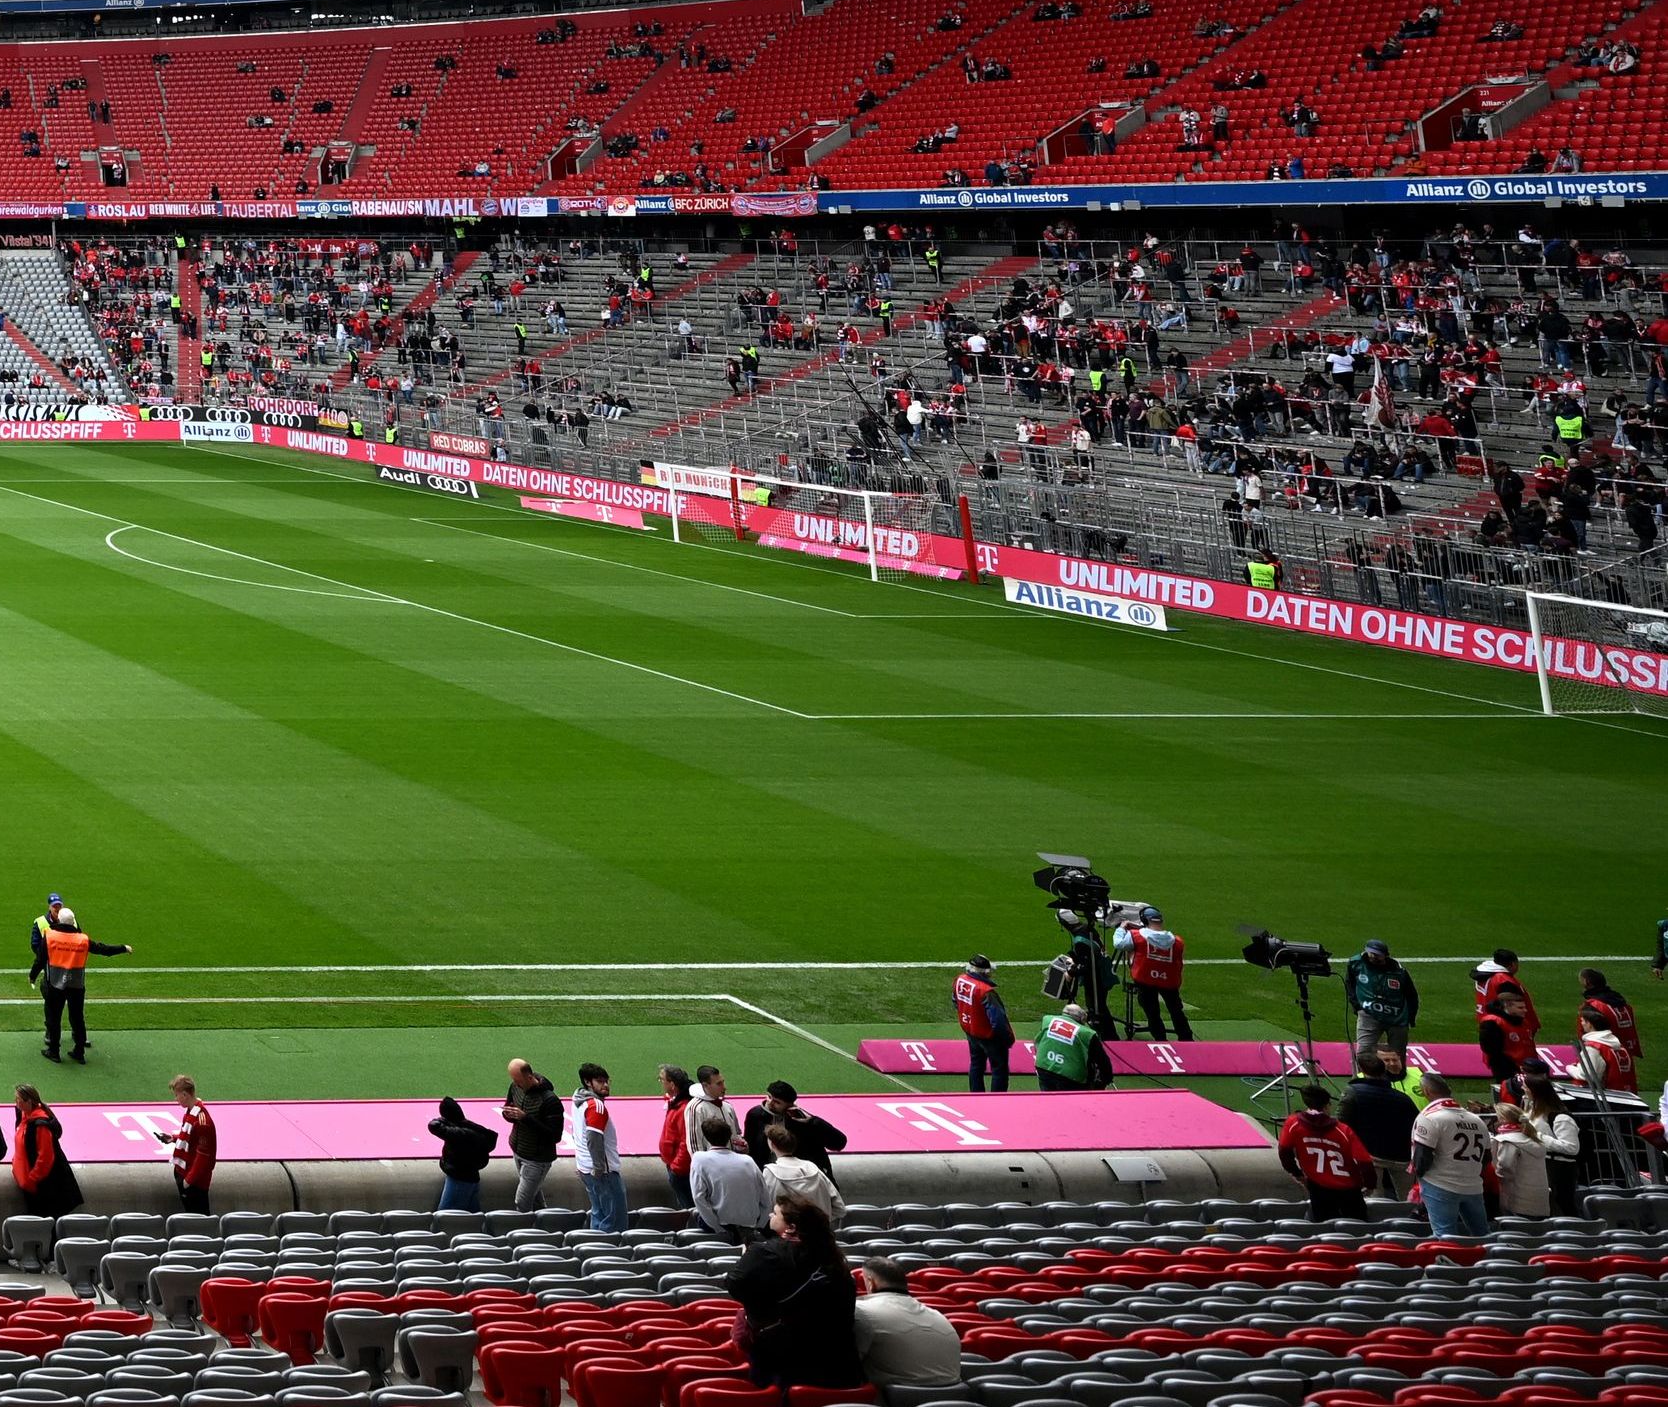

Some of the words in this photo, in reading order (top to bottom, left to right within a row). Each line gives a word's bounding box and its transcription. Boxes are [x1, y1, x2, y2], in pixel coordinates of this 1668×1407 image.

[1406, 183, 1464, 196] Allianz
[1494, 180, 1553, 195] Global
[1557, 179, 1647, 195] Investors
[426, 198, 480, 216] MAHL
[674, 198, 693, 210] BFC
[693, 197, 729, 210] ZÜRICH
[919, 194, 957, 205] Allianz
[974, 193, 1012, 203] Global
[1014, 191, 1069, 203] Investors
[223, 203, 296, 217] TAUBERTAL
[248, 396, 318, 416] ROHRDORF
[183, 423, 231, 438] Allianz
[286, 431, 349, 456] UNLIMITED
[451, 437, 487, 454] COBRAS
[379, 468, 421, 486] Audi
[402, 450, 472, 477] UNLIMITED
[482, 462, 528, 491] DATEN
[530, 471, 571, 498] OHNE
[794, 514, 919, 557] UNLIMTED
[1015, 580, 1121, 620] Allianz
[1059, 558, 1214, 609] UNLIMITED
[1246, 589, 1353, 635] DATEN
[1360, 609, 1465, 655] OHNE
[1046, 1049, 1066, 1065] 06
[1452, 1131, 1485, 1163] 25
[1305, 1147, 1351, 1178] 72
